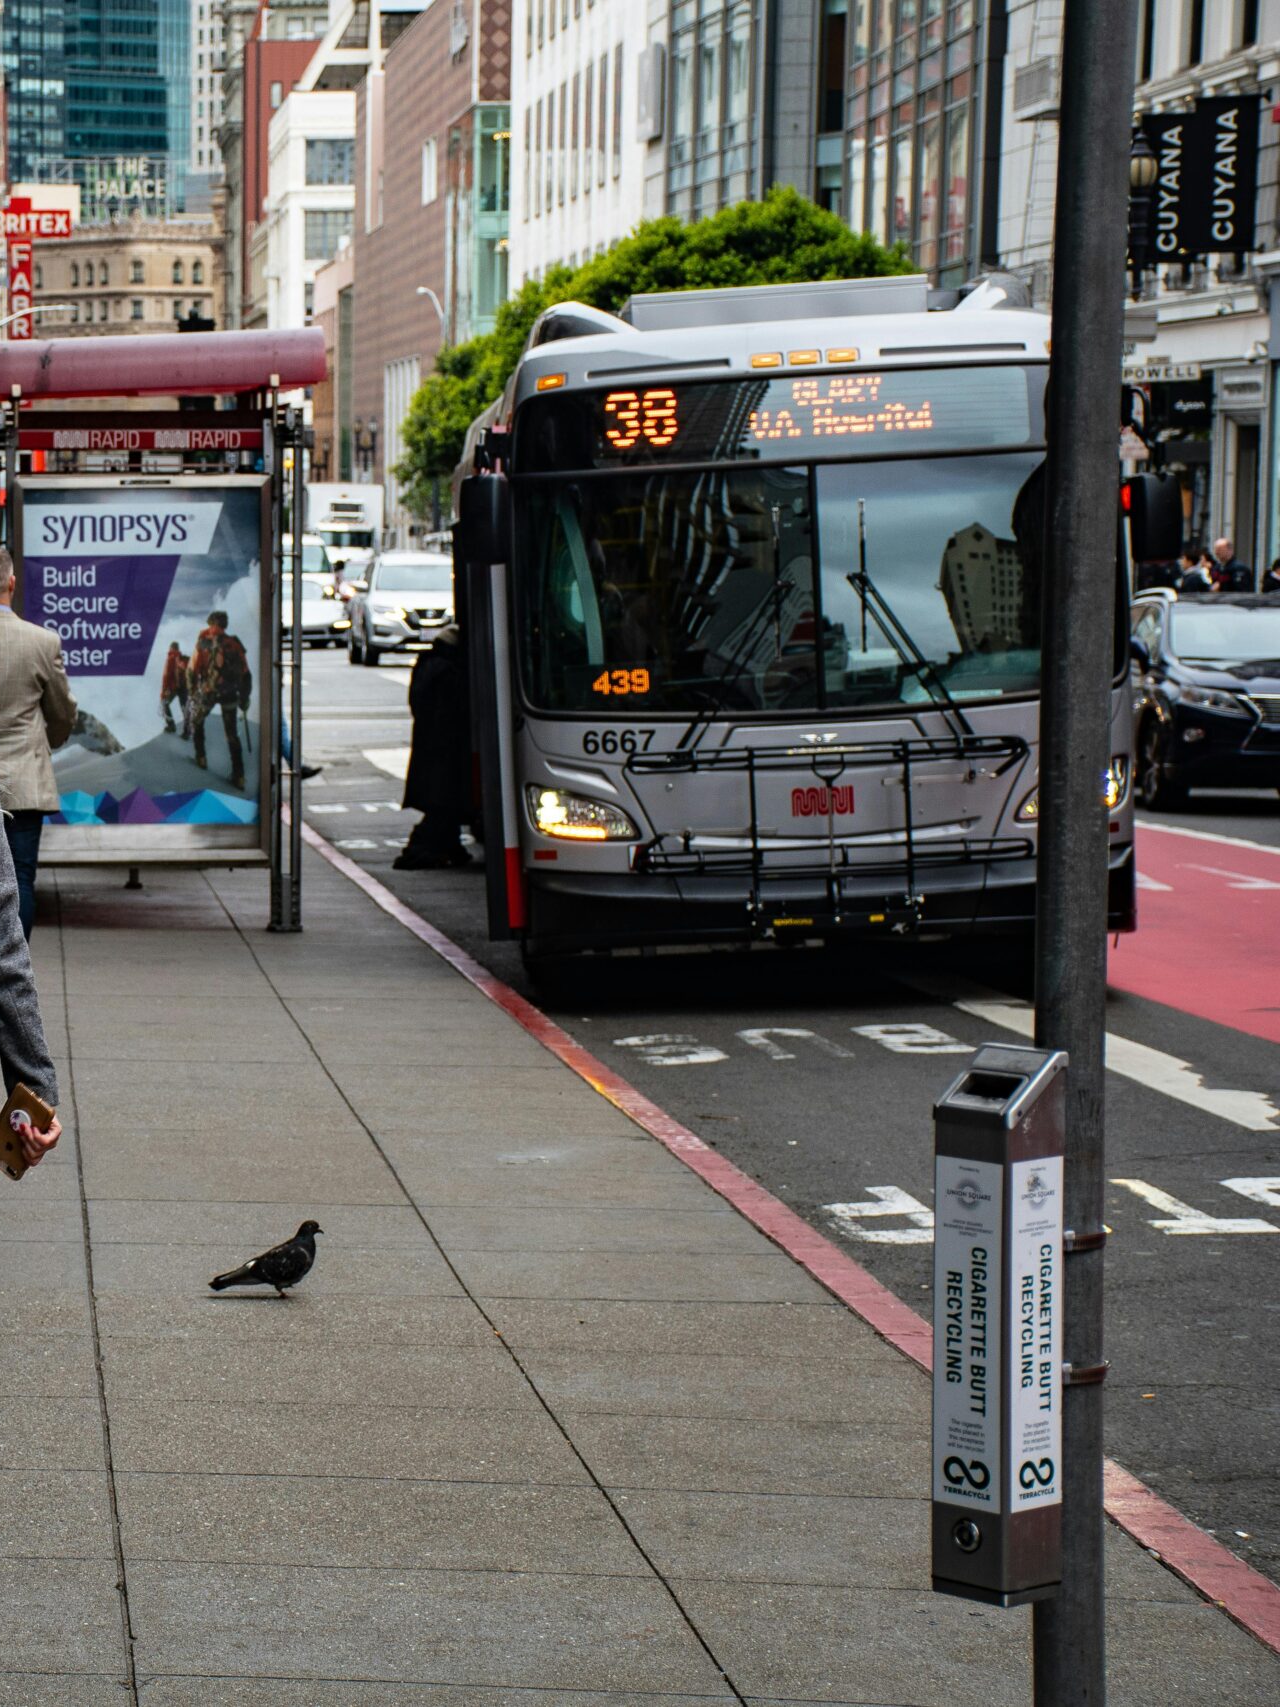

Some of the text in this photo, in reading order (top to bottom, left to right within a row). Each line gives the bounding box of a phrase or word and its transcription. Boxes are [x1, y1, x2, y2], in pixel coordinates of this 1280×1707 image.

[116, 157, 150, 177] THE
[1211, 108, 1239, 241] CUYANA
[96, 179, 167, 199] PALACE
[1156, 125, 1184, 252] CUYANA
[10, 243, 32, 338] FABR
[1124, 366, 1196, 379] POWELL
[605, 389, 678, 447] 38
[90, 430, 140, 449] RAPID
[192, 430, 241, 449] RAPID
[42, 514, 188, 549] SYNOPSYS
[43, 565, 97, 587] Build
[43, 592, 119, 614] Secure
[61, 646, 112, 666] aster
[592, 668, 650, 696] 439
[582, 729, 656, 754] 6667
[613, 1022, 980, 1066] BUS
[946, 1189, 992, 1201] UNION SQUARE
[1038, 1189, 1055, 1198] SQUARE
[946, 1270, 963, 1384] RECYCLING
[970, 1247, 988, 1418] CIGARETTE BUTT
[1021, 1275, 1034, 1388] RECYCLING
[1039, 1244, 1053, 1412] CIGARETTE BUTT
[943, 1485, 991, 1501] TERRACYCLE
[1019, 1487, 1055, 1500] TERRACYCLE
